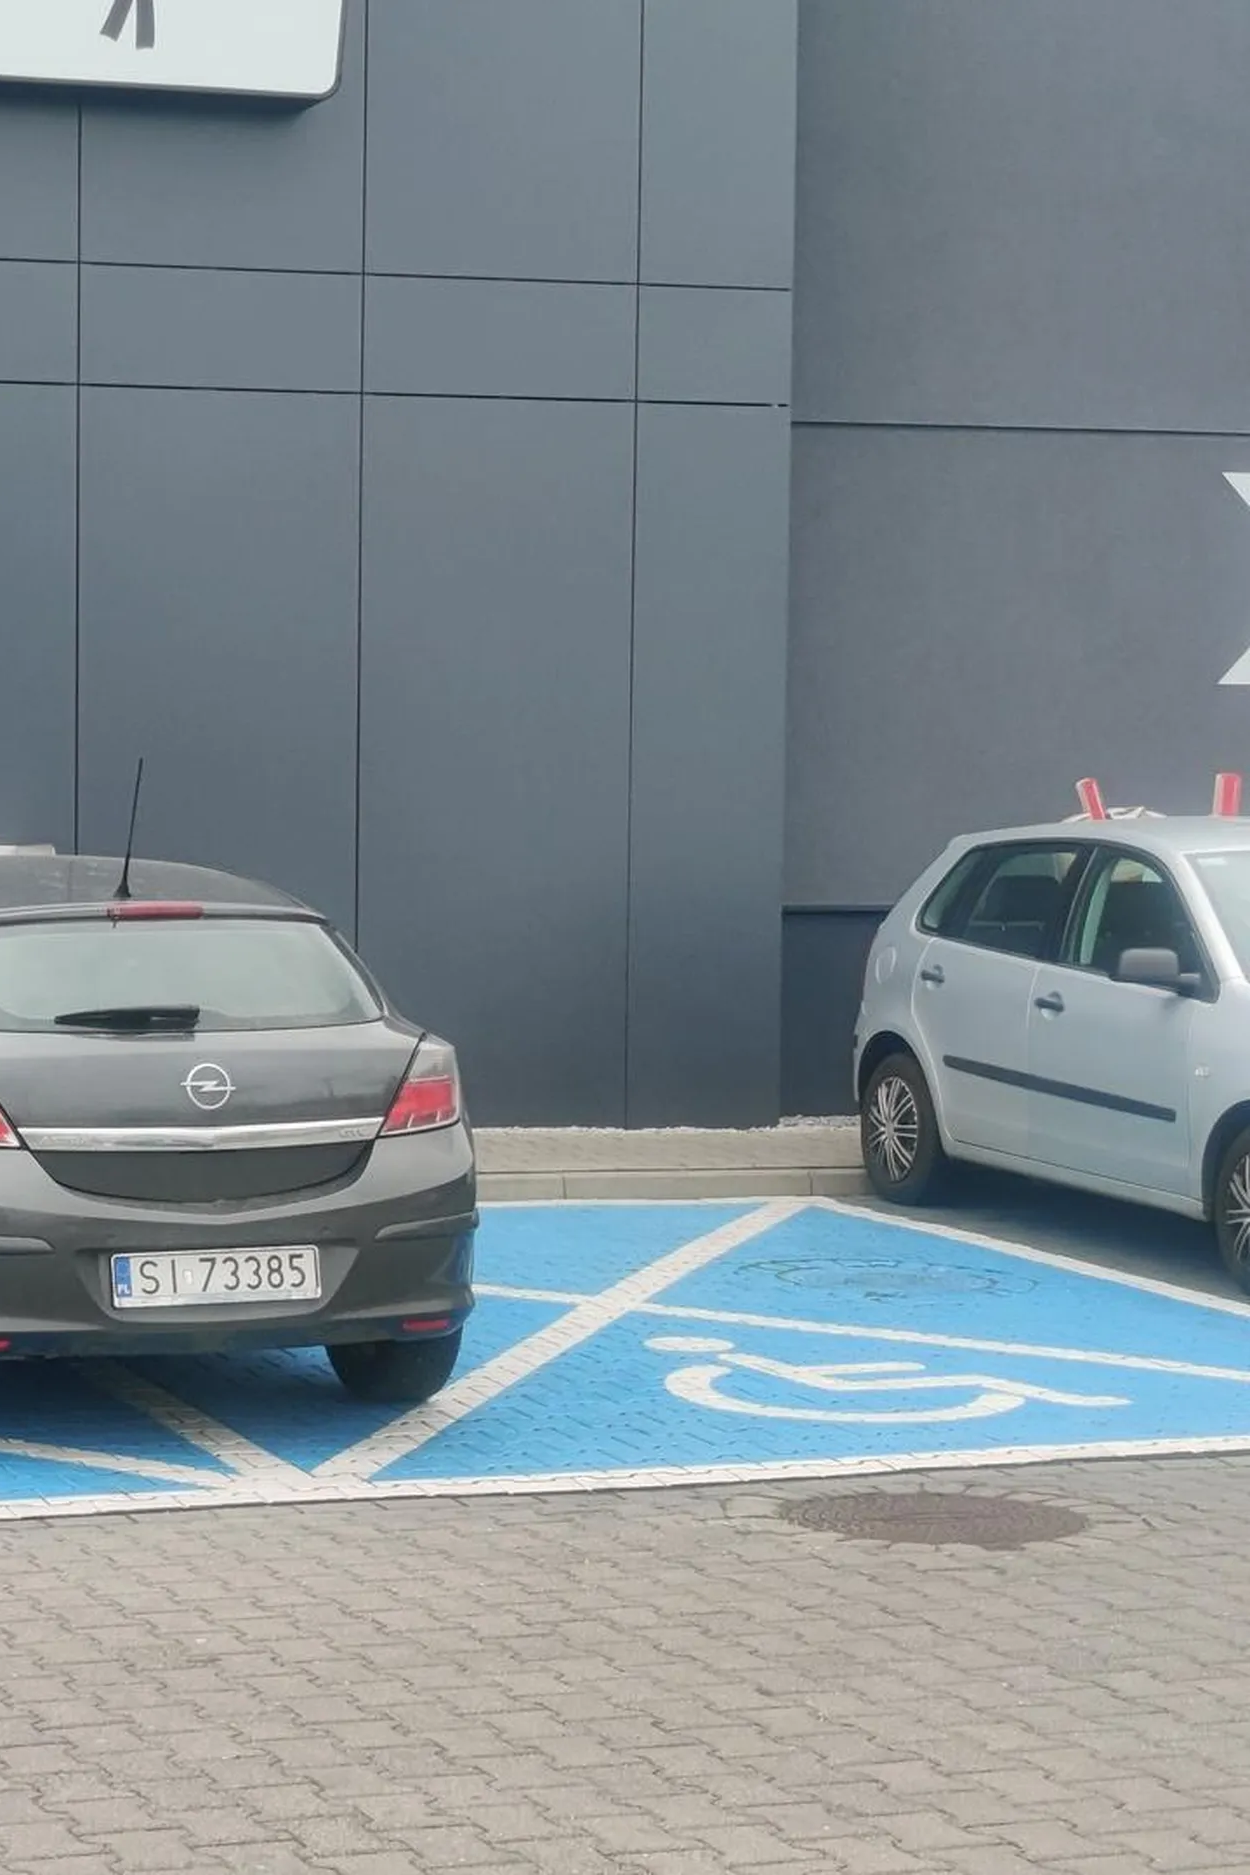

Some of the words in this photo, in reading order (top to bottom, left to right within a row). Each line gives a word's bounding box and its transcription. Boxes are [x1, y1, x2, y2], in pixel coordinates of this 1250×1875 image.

[139, 1259, 178, 1294] SI
[199, 1253, 306, 1293] 73385
[117, 1284, 131, 1296] PL
